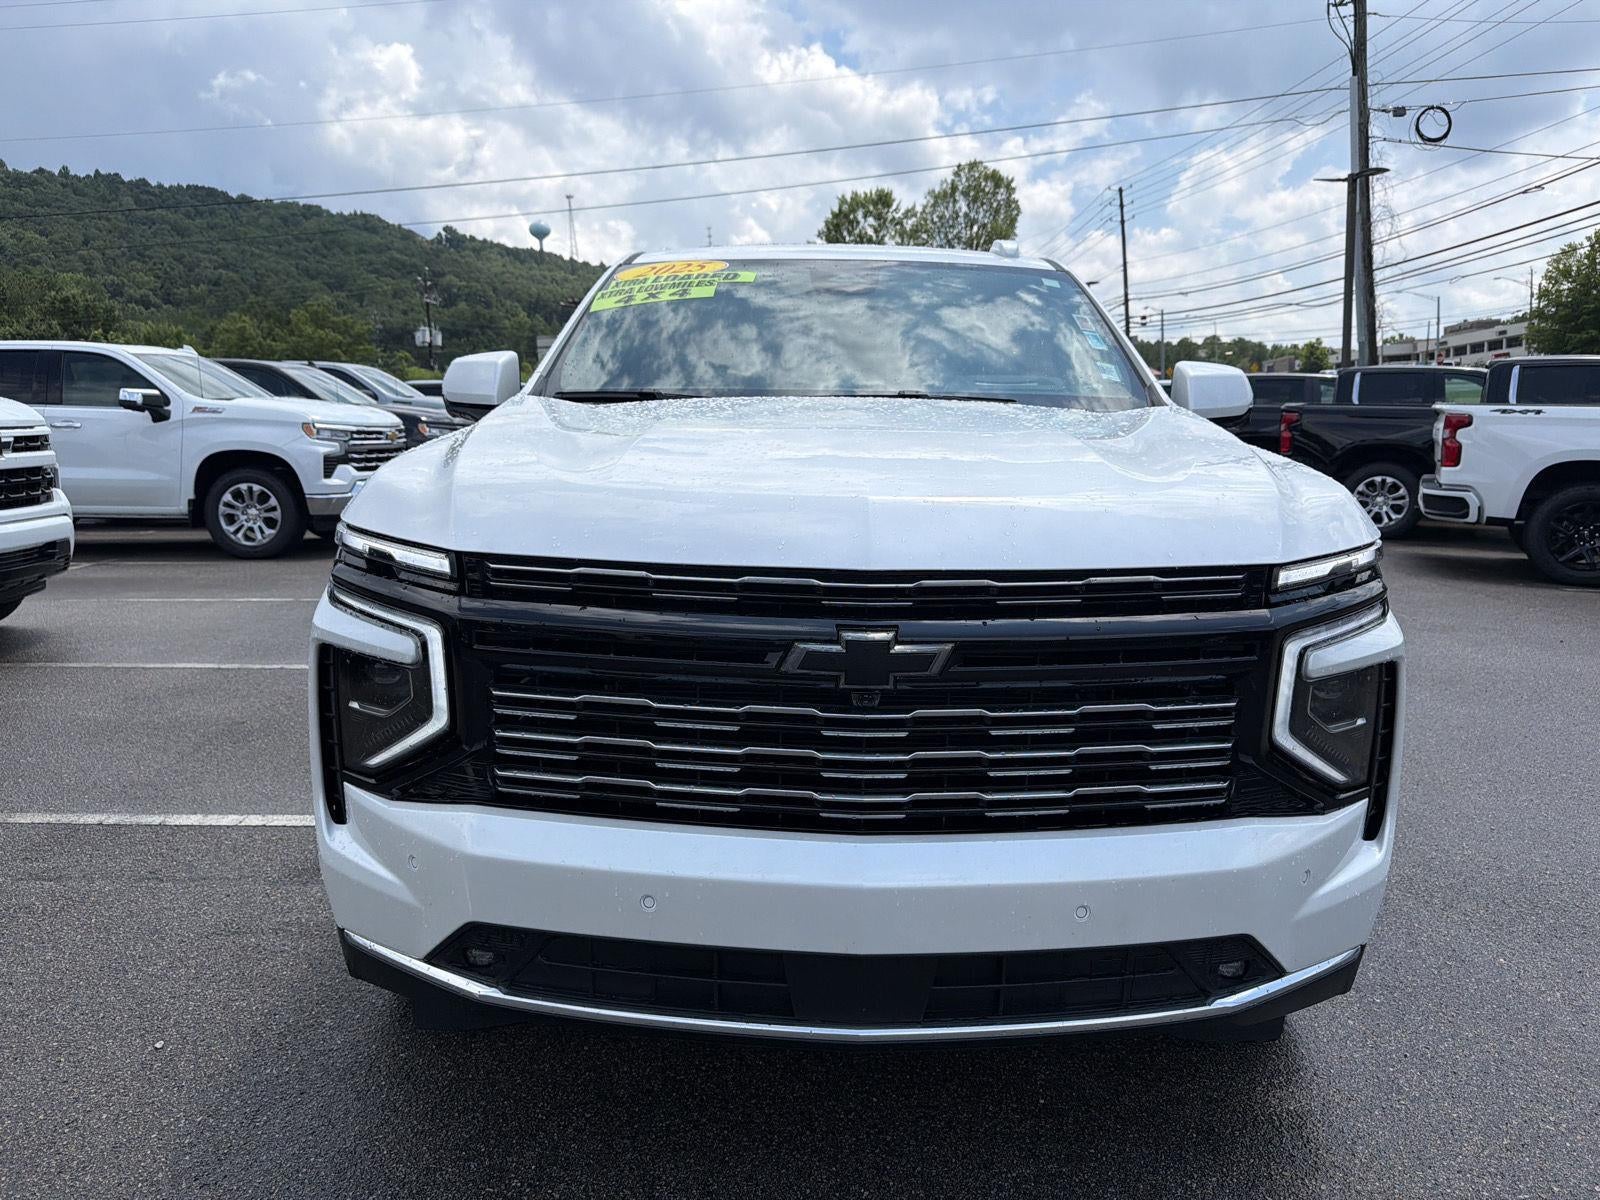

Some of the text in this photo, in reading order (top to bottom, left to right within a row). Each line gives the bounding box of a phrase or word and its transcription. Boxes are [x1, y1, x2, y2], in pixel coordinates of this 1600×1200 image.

[632, 262, 709, 278] 2025
[652, 272, 741, 284] LOADED
[598, 288, 634, 300] XTRA
